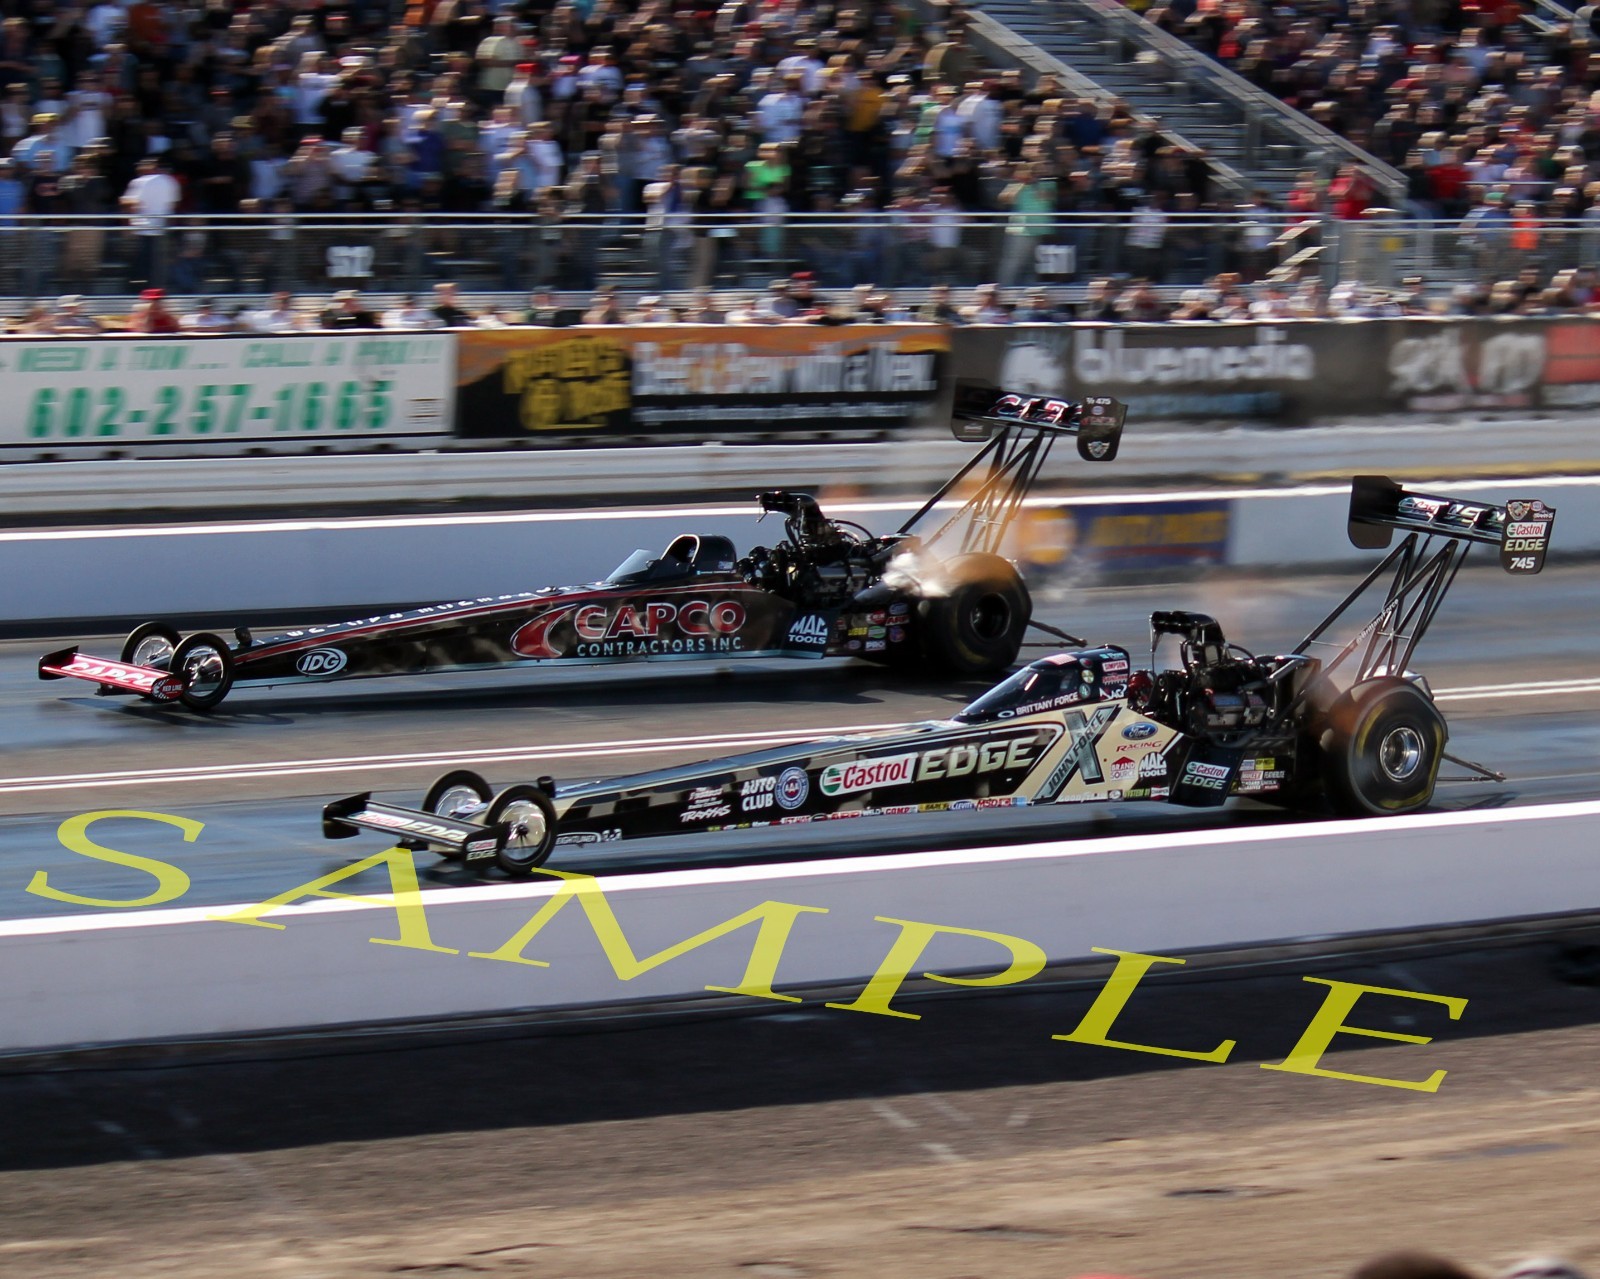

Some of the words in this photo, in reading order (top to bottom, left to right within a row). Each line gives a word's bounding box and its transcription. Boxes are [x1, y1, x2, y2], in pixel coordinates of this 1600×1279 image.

[1074, 329, 1313, 383] bluemedia
[26, 380, 394, 438] 602-257-1665
[1516, 524, 1543, 535] Castrol
[1504, 538, 1545, 551] EDGE
[1510, 556, 1535, 569] 745
[573, 600, 746, 640] CAPCO
[789, 614, 828, 636] MAC
[577, 639, 706, 657] CONTRACTORS
[788, 634, 827, 645] TOOLS
[301, 654, 340, 672] IDG
[1016, 699, 1053, 715] BRITTANY
[1054, 692, 1079, 706] FORCE
[1128, 724, 1151, 737] Ford
[1048, 756, 1076, 795] JOHN
[1073, 710, 1106, 756] FORCE
[1116, 740, 1163, 752] RACING
[843, 758, 909, 789] Castrol
[916, 736, 1039, 782] EDGE
[1111, 761, 1136, 771] BRAND
[1139, 752, 1167, 772] MAC
[1196, 764, 1226, 777] Castrol
[1139, 769, 1167, 778] TOOLS
[1181, 774, 1226, 789] EDGE
[741, 776, 776, 795] AUTO
[741, 794, 774, 812] CLUB
[680, 804, 731, 823] TRAXXAS
[403, 821, 468, 843] EDG
[466, 849, 497, 861] EDGE
